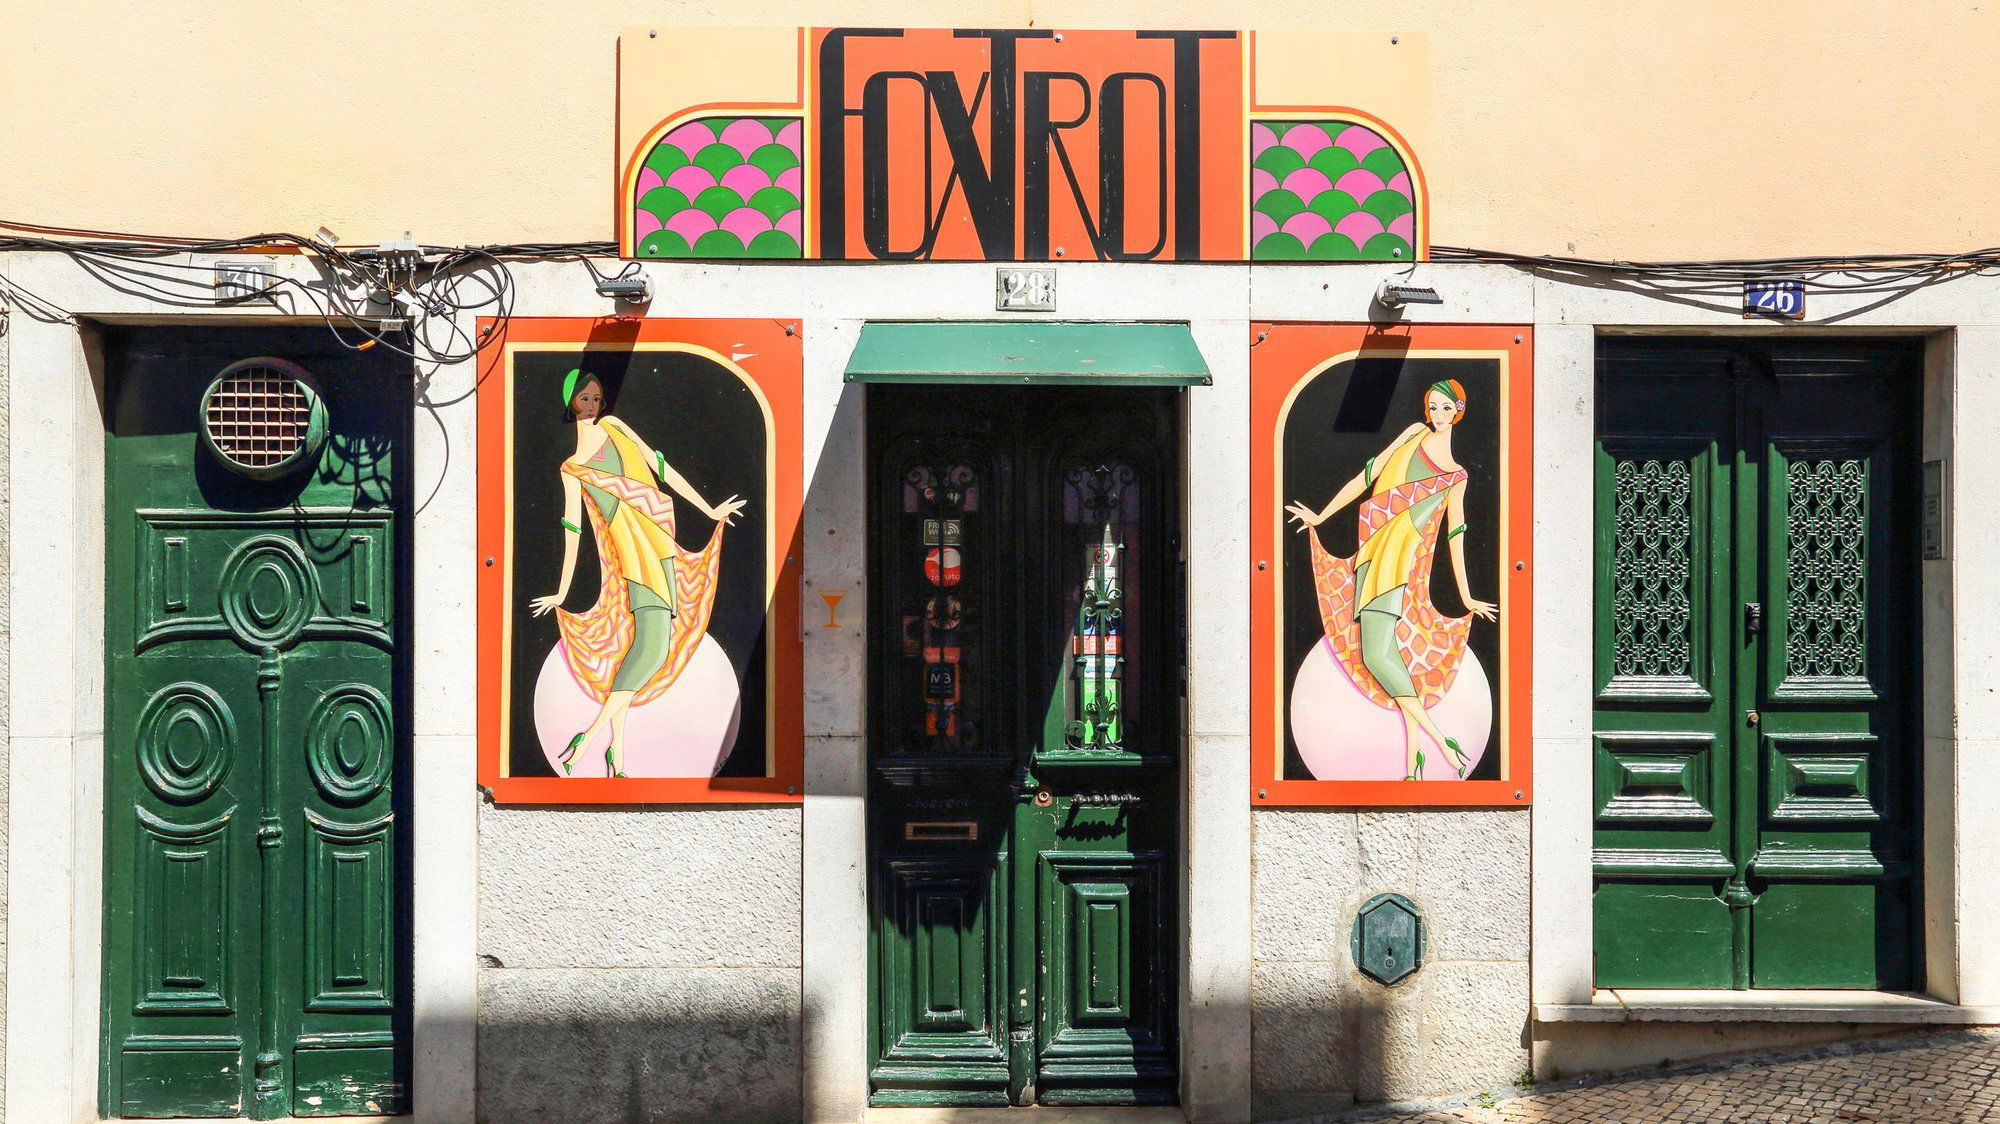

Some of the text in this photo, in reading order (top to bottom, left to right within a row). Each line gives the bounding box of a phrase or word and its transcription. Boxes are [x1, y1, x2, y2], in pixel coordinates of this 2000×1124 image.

[820, 28, 1237, 260] FOXTROT
[227, 266, 263, 300] 30
[1009, 272, 1045, 305] 28
[1757, 281, 1794, 312] 26
